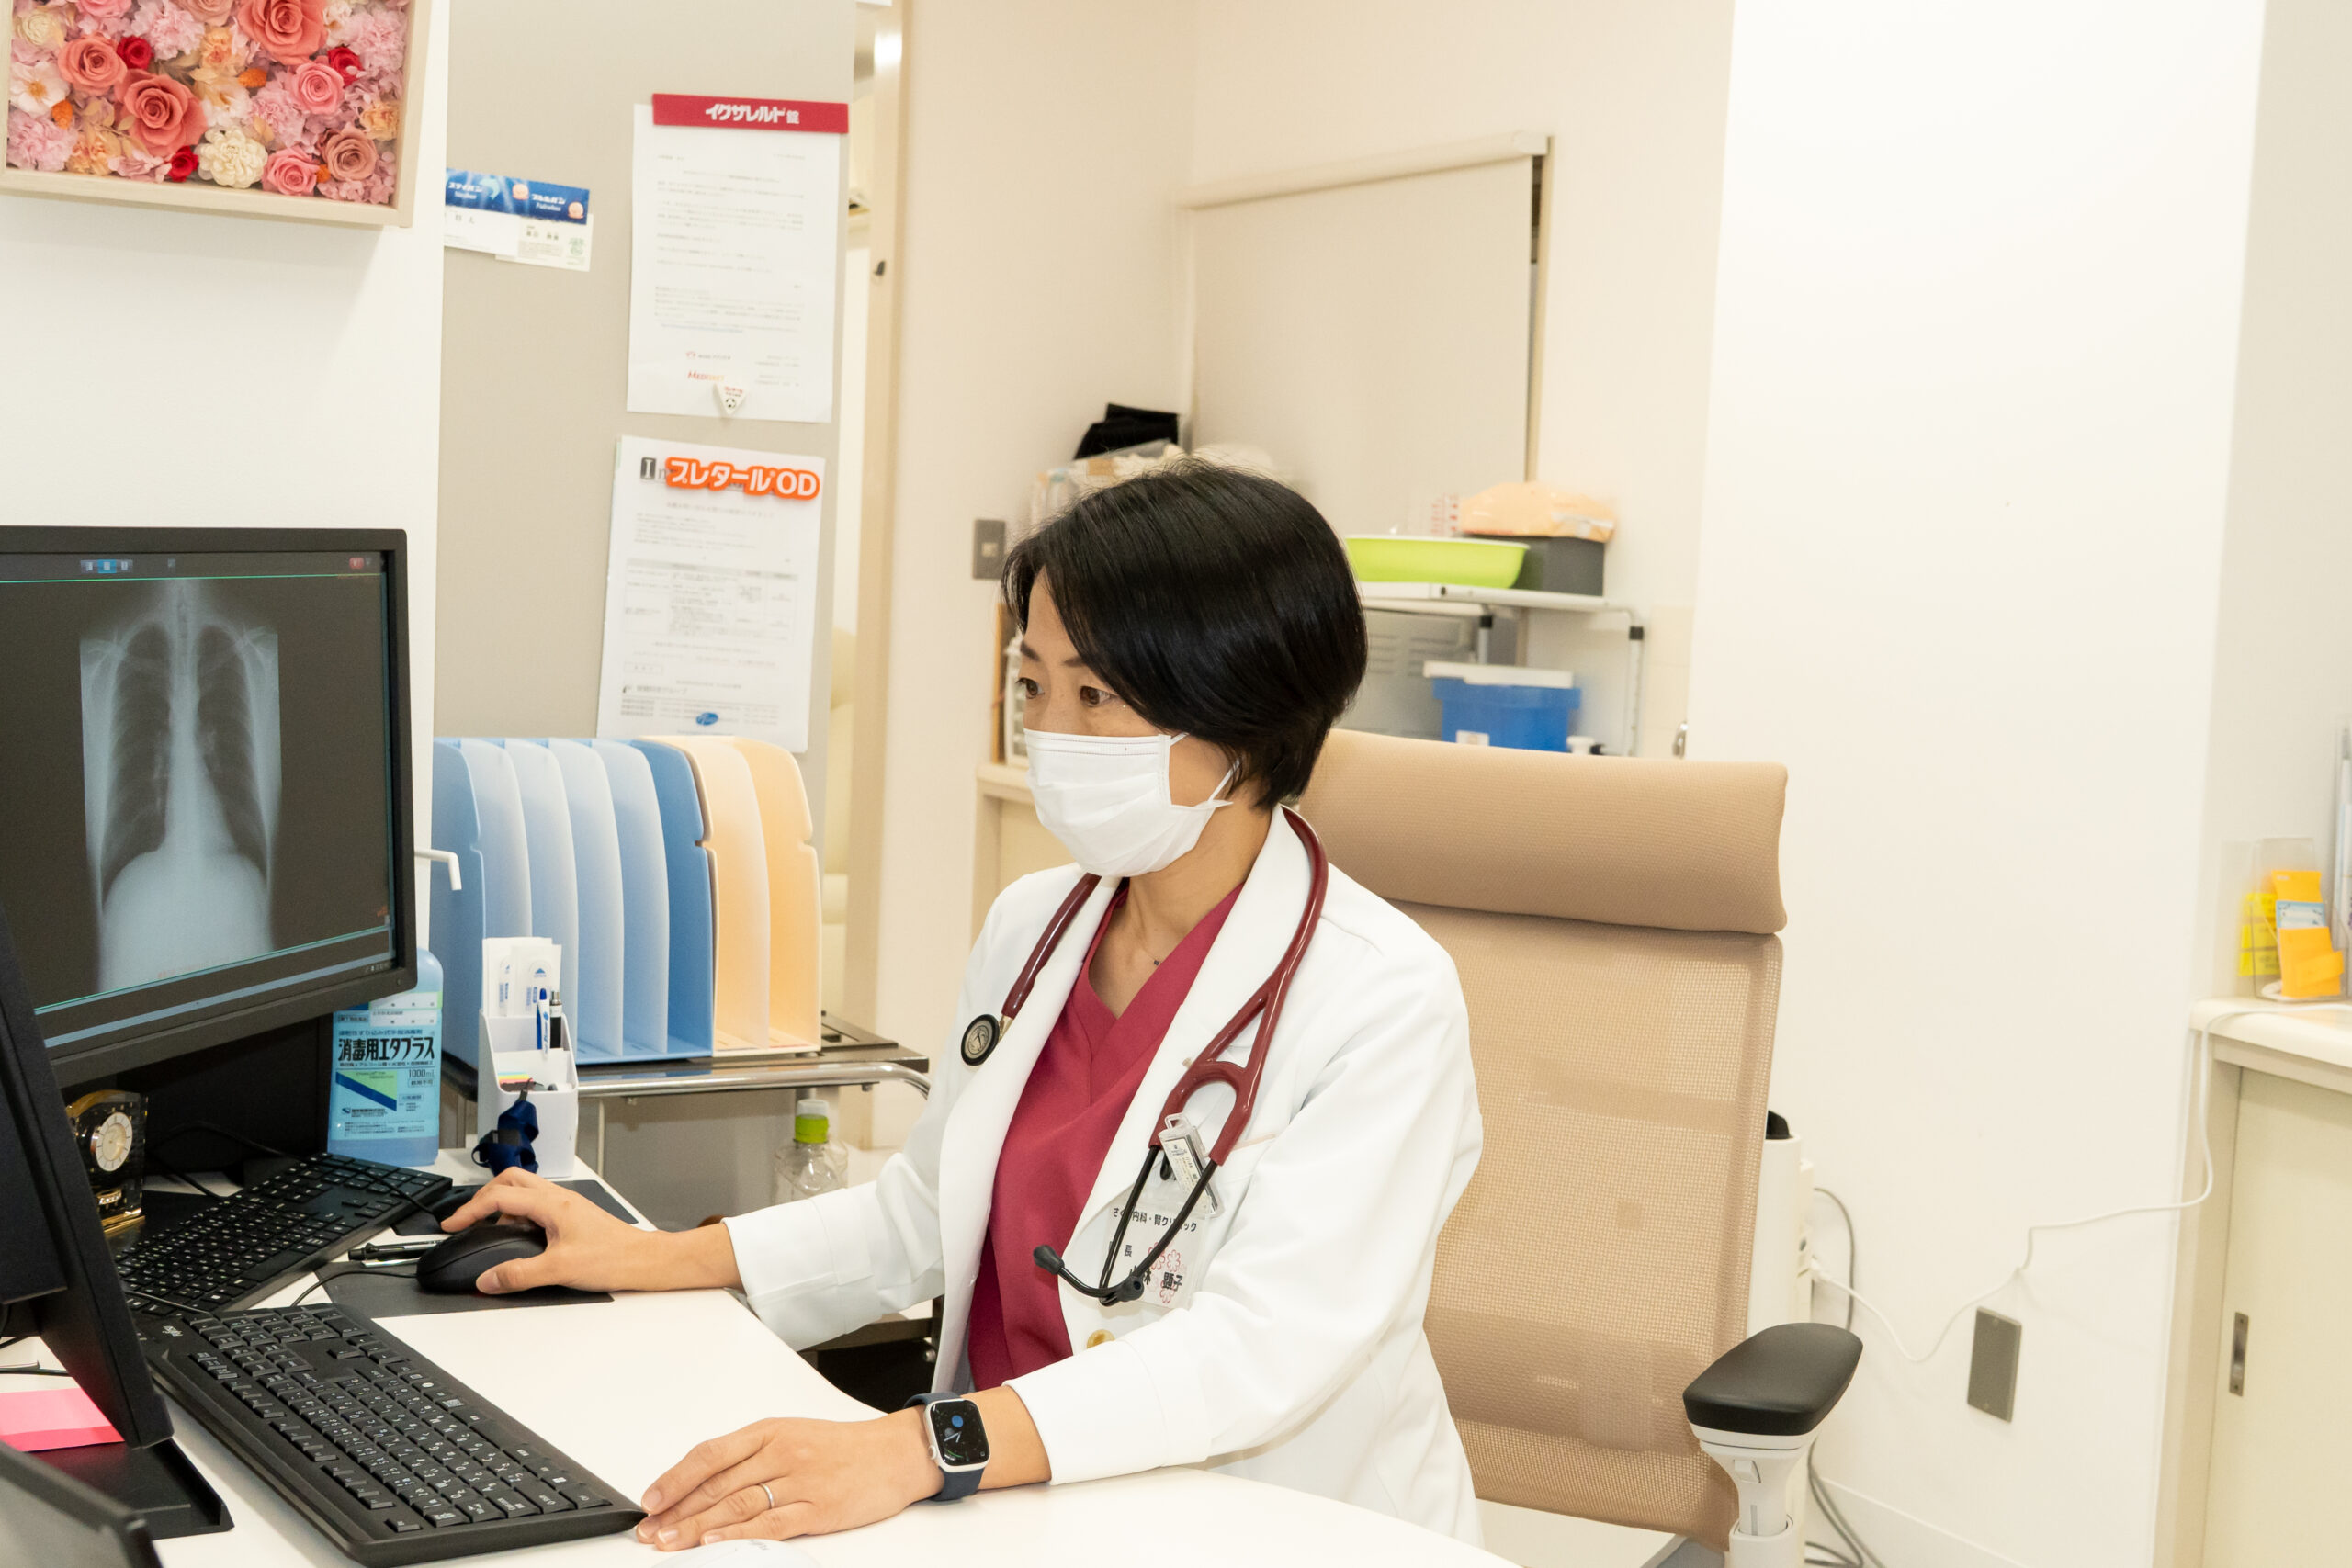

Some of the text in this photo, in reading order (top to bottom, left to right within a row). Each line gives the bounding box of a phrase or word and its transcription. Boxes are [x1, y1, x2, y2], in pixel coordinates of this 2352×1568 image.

[337, 1036, 435, 1061] 消毒用エタプラス
